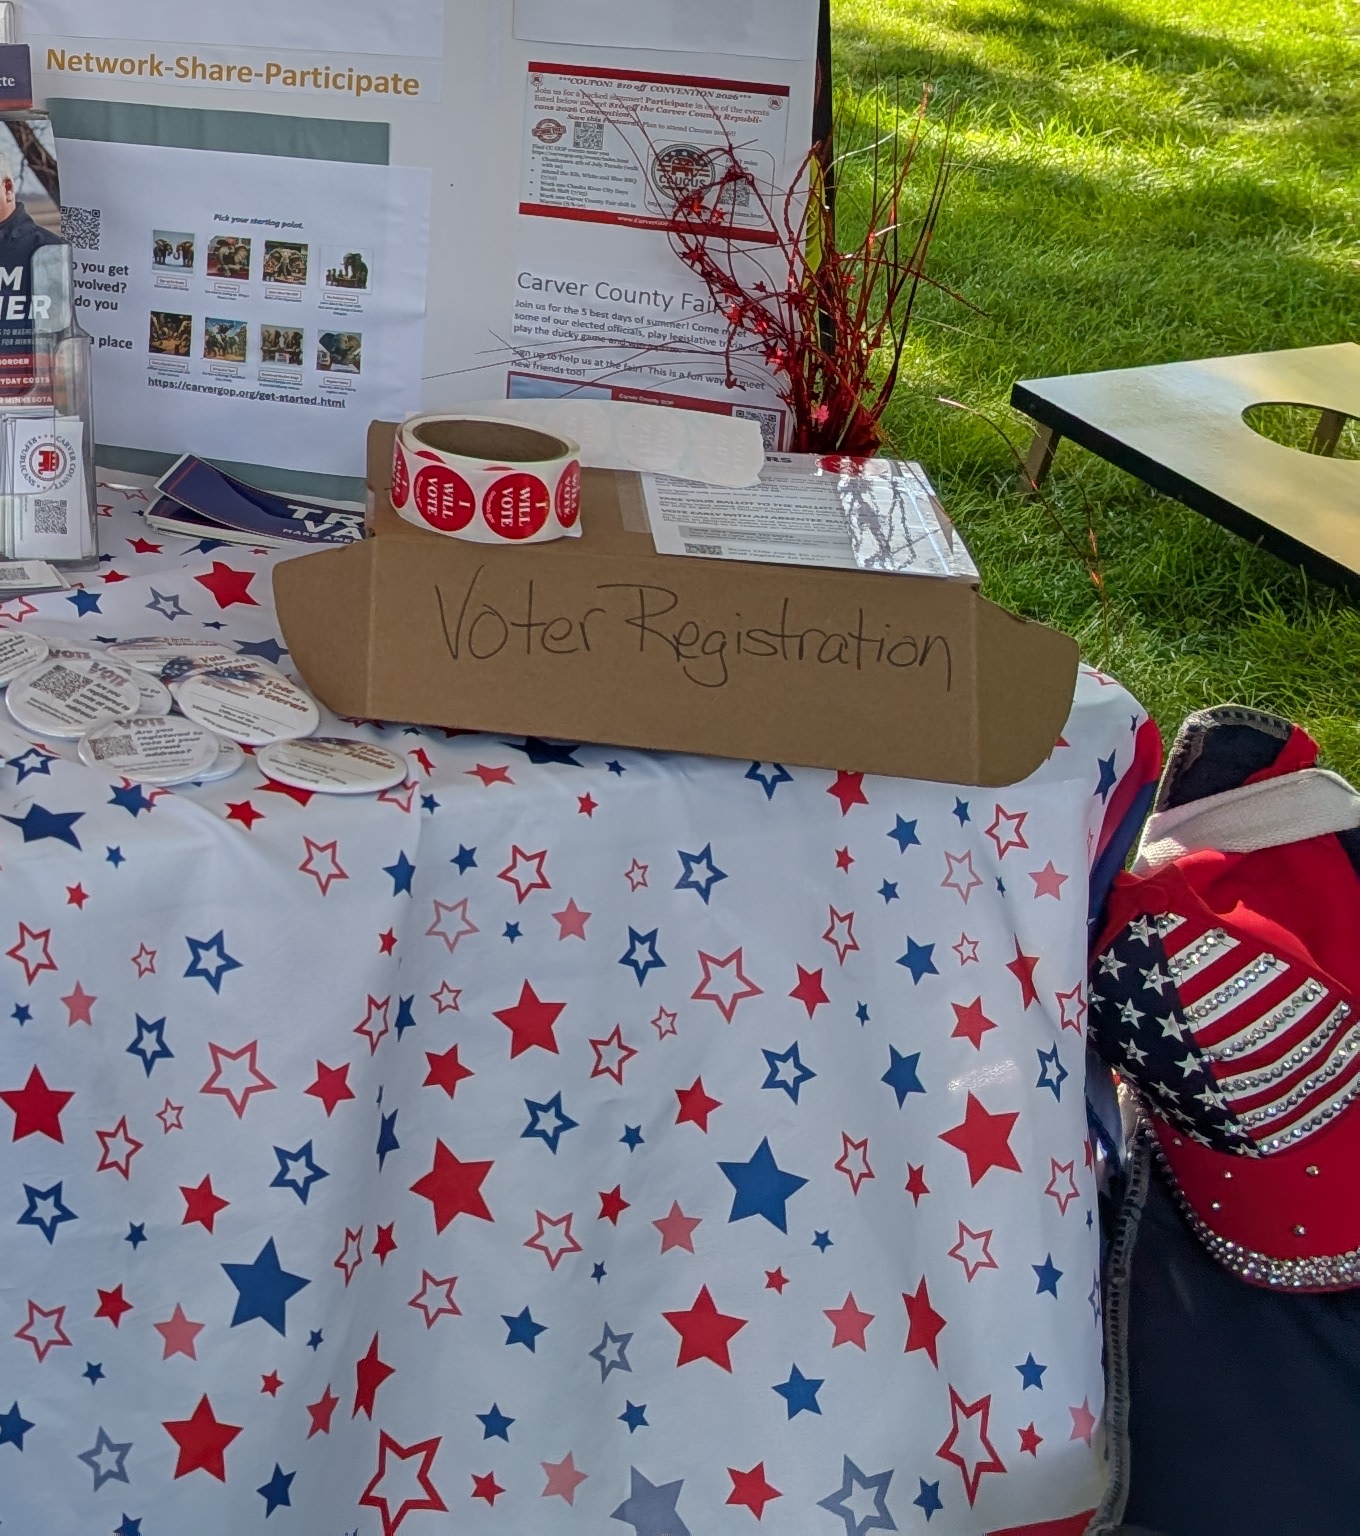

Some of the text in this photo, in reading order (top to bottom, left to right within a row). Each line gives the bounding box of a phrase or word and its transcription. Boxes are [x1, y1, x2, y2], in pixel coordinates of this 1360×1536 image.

[46, 47, 421, 96] Network-Share-Participate
[81, 262, 129, 276] you get
[74, 295, 119, 311] do you
[517, 272, 673, 312] Carver County
[515, 300, 632, 323] Join the best days
[99, 336, 133, 352] place
[427, 477, 438, 516] VOTE
[442, 483, 454, 519] WILL
[501, 487, 514, 528] VOTE
[519, 487, 530, 527] WILL
[283, 528, 319, 538] MAKE
[434, 563, 956, 692] Voter Registration
[48, 649, 91, 659] VOTE
[88, 662, 128, 687] VOTE
[114, 717, 166, 729] VOTE
